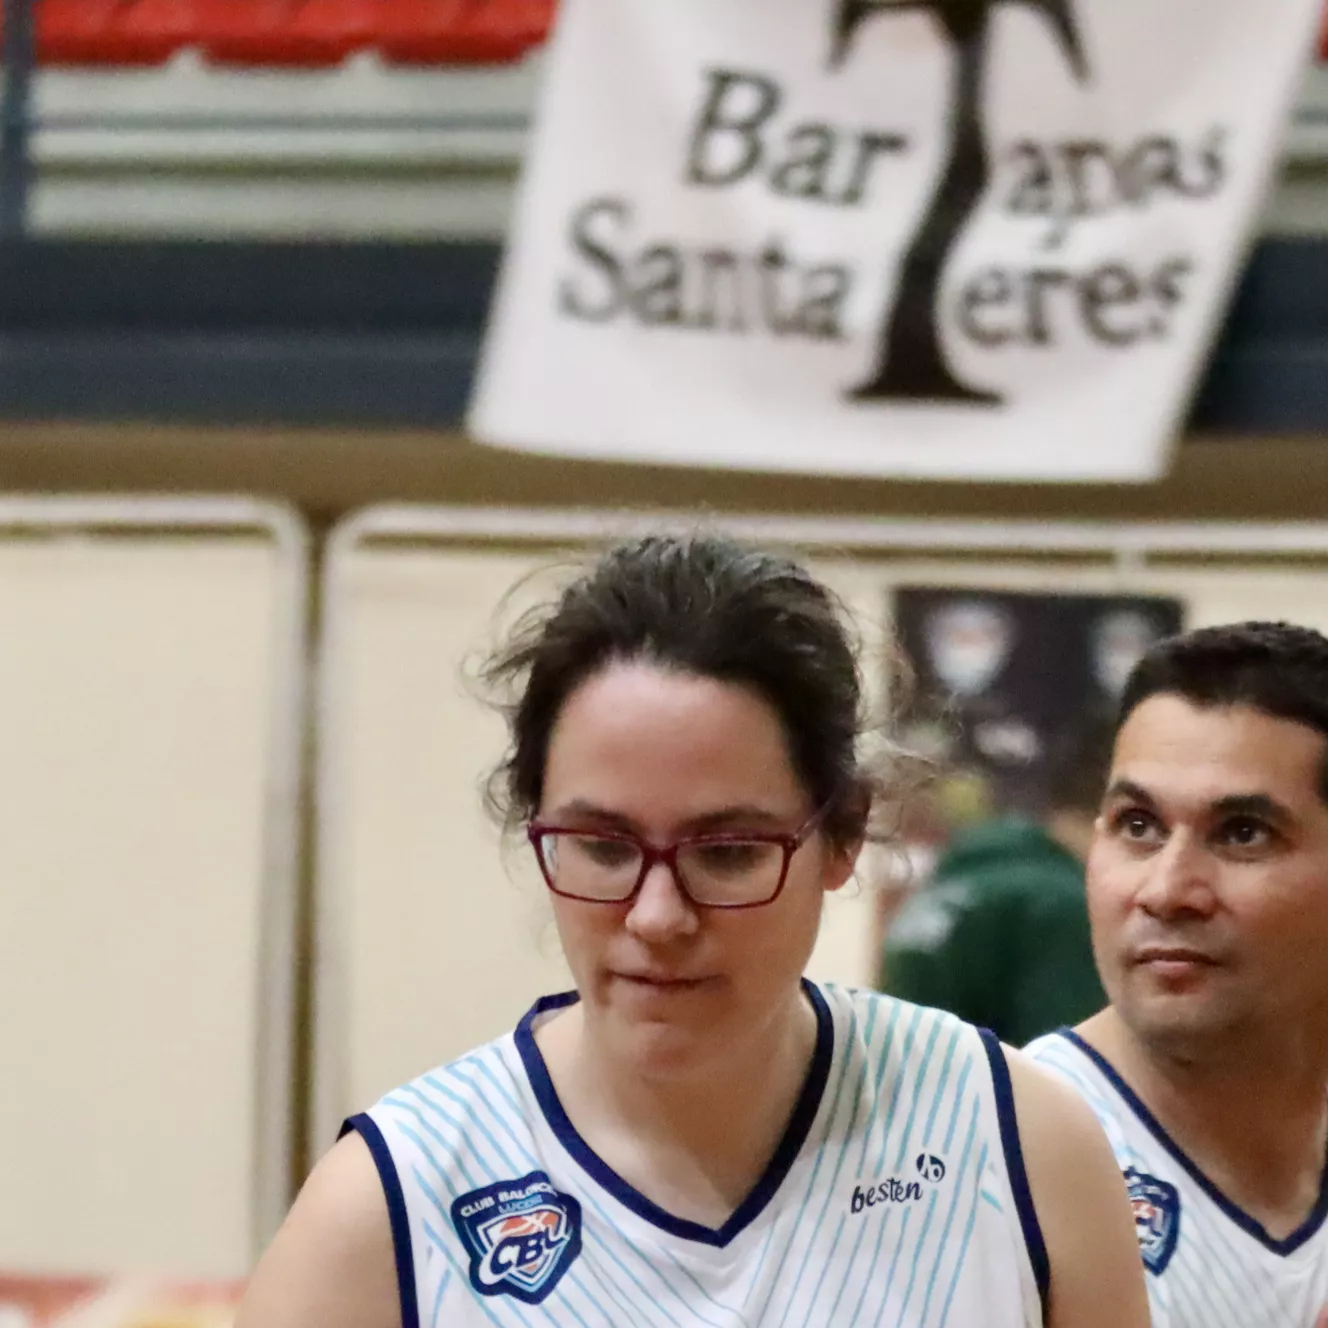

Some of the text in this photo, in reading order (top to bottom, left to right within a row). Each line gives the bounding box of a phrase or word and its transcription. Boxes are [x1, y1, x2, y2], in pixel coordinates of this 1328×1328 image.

[680, 65, 907, 205] Bar
[557, 198, 854, 345] Santa
[851, 1177, 923, 1214] besten
